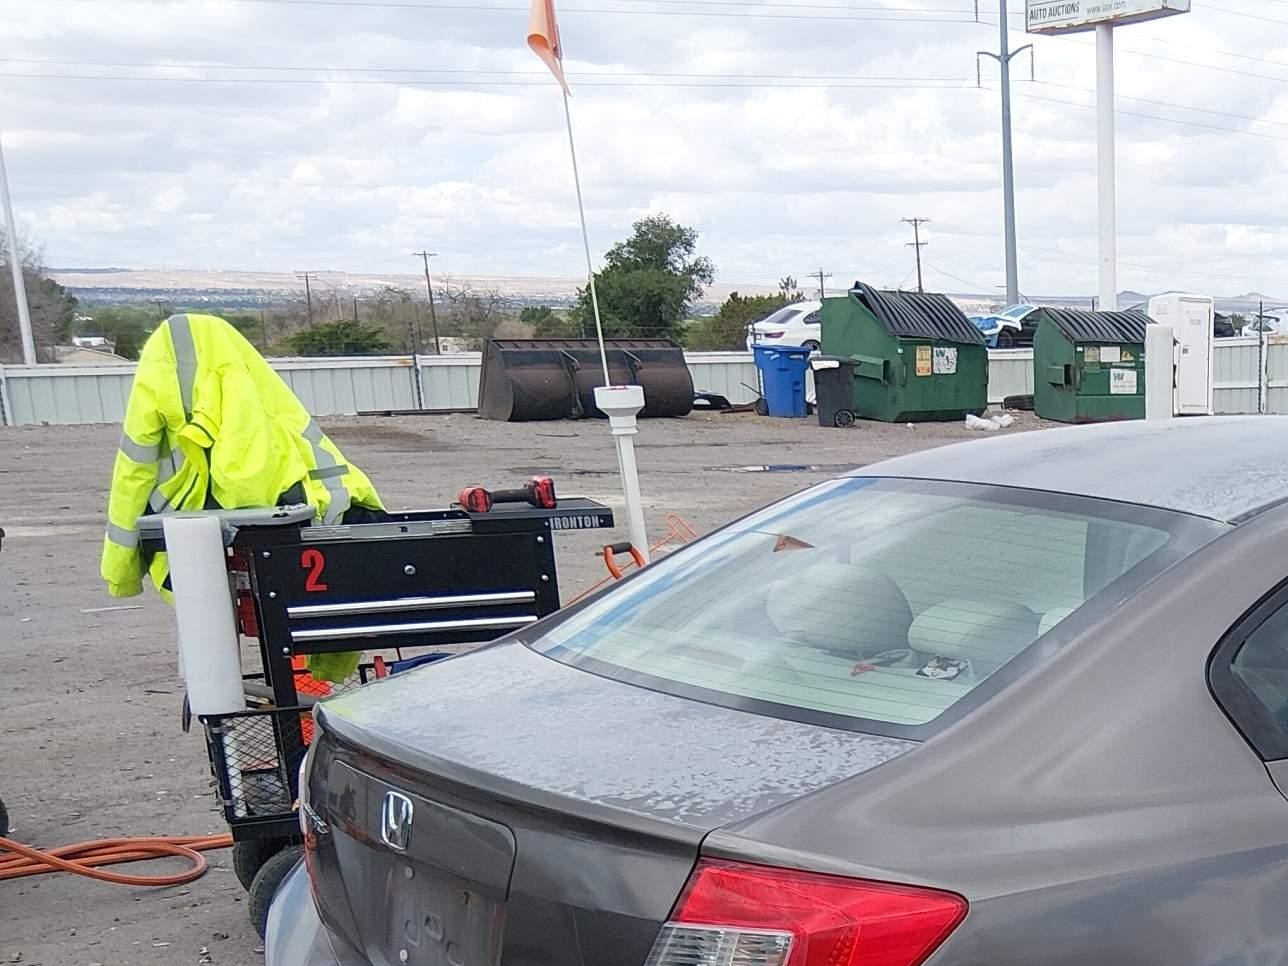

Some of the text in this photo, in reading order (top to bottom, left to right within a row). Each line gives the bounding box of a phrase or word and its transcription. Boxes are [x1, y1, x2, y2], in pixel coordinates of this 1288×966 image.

[1029, 2, 1080, 21] AUTO AUCTIONS
[549, 515, 599, 530] IRONTON
[302, 548, 328, 592] 2
